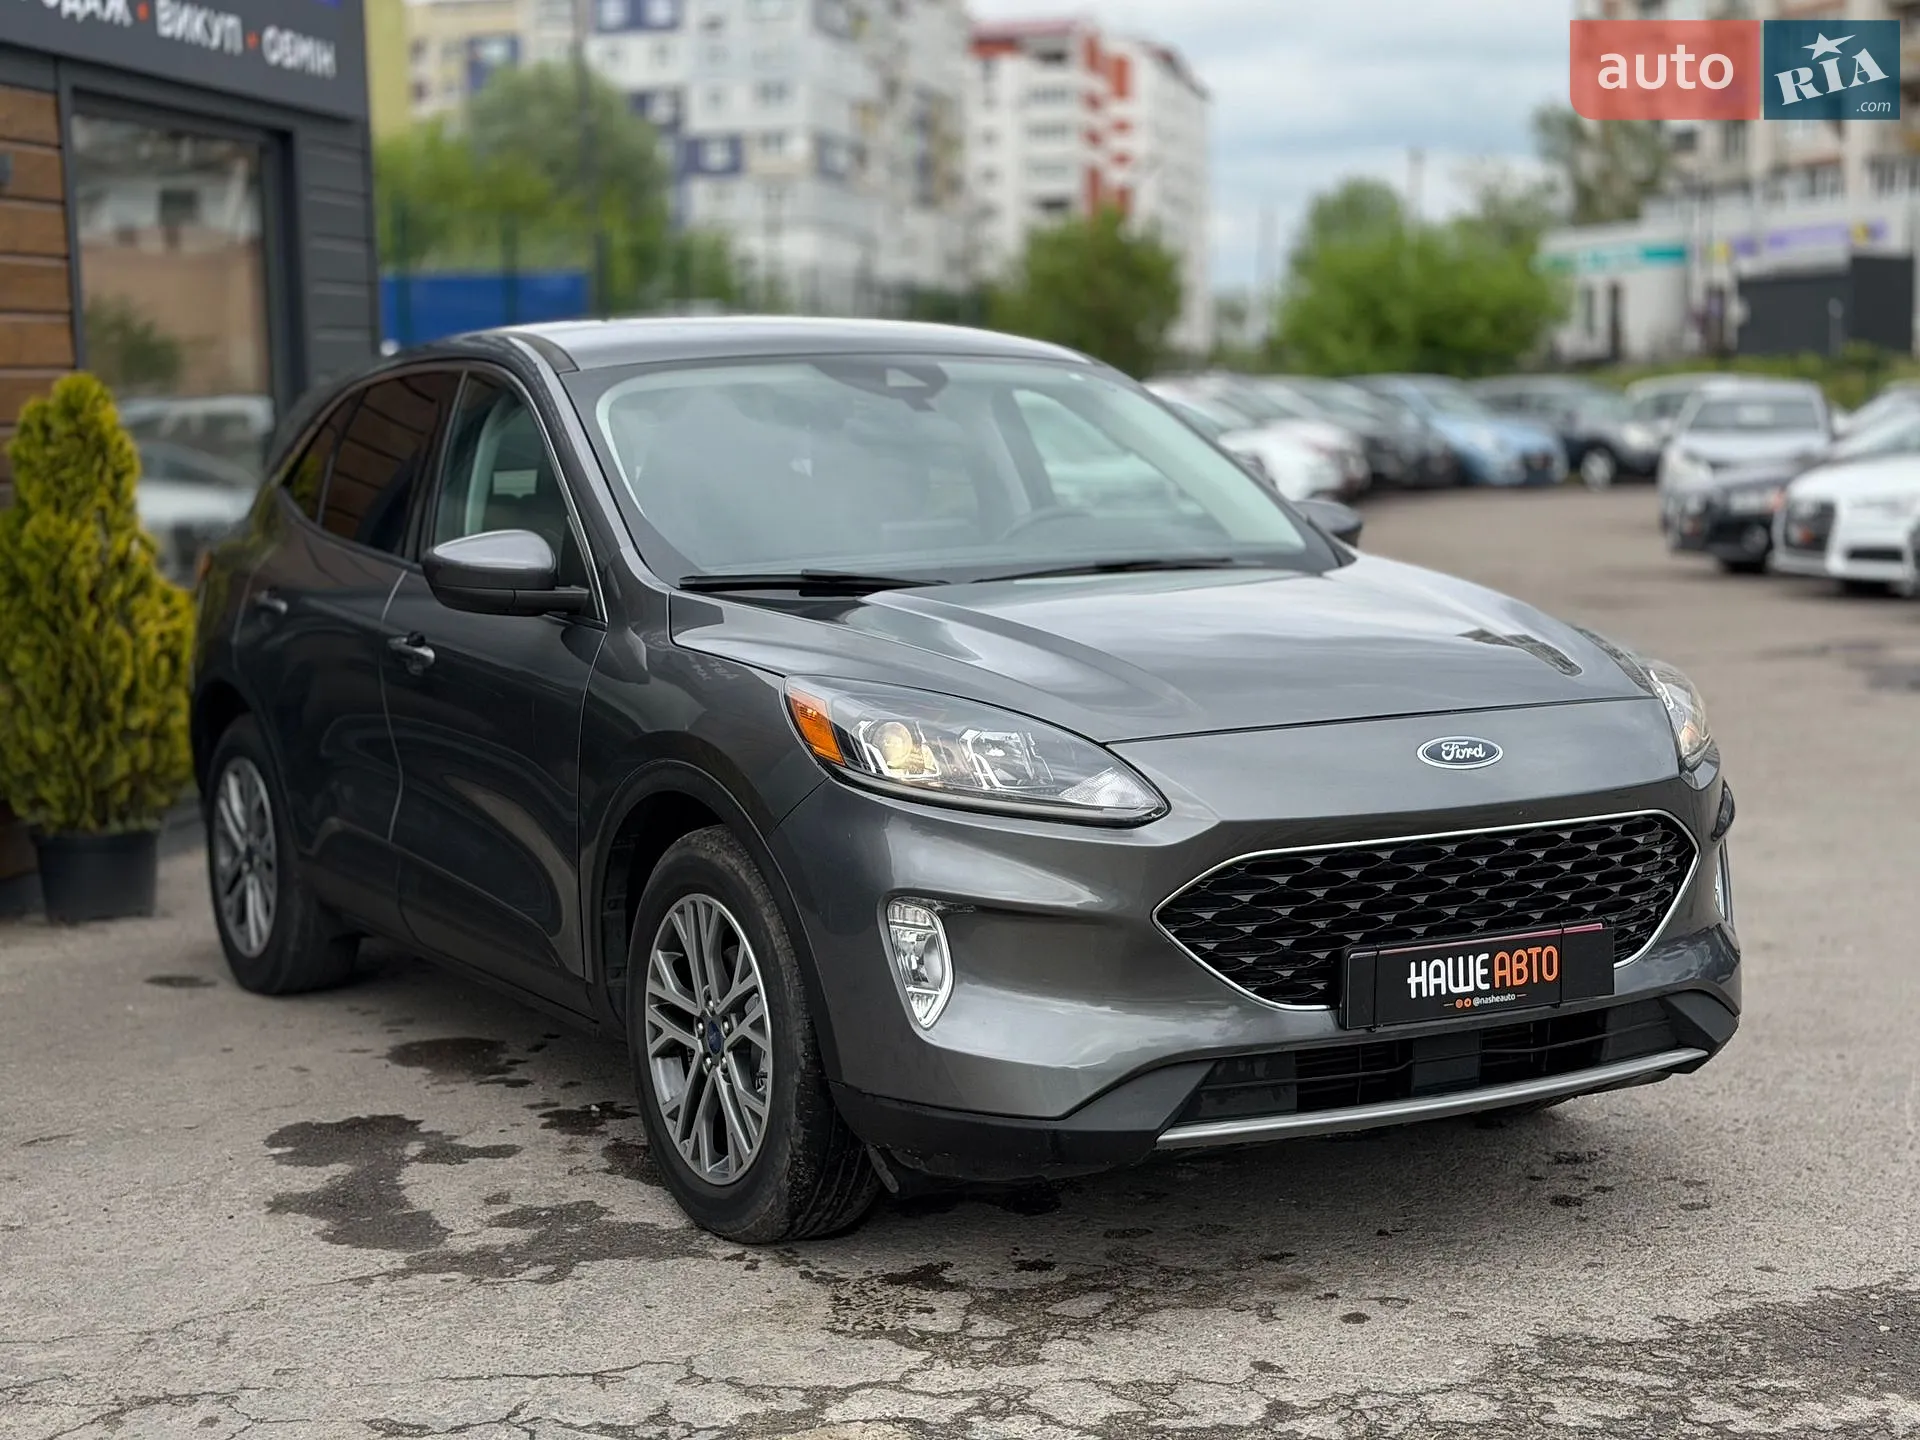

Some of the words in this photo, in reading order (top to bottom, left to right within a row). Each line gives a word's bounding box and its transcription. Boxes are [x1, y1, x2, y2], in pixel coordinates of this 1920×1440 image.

[1440, 741, 1486, 761] Ford
[1407, 953, 1490, 999] НАШЕ
[1493, 945, 1559, 989] АВТО
[1472, 993, 1516, 1007] @nasheauto
